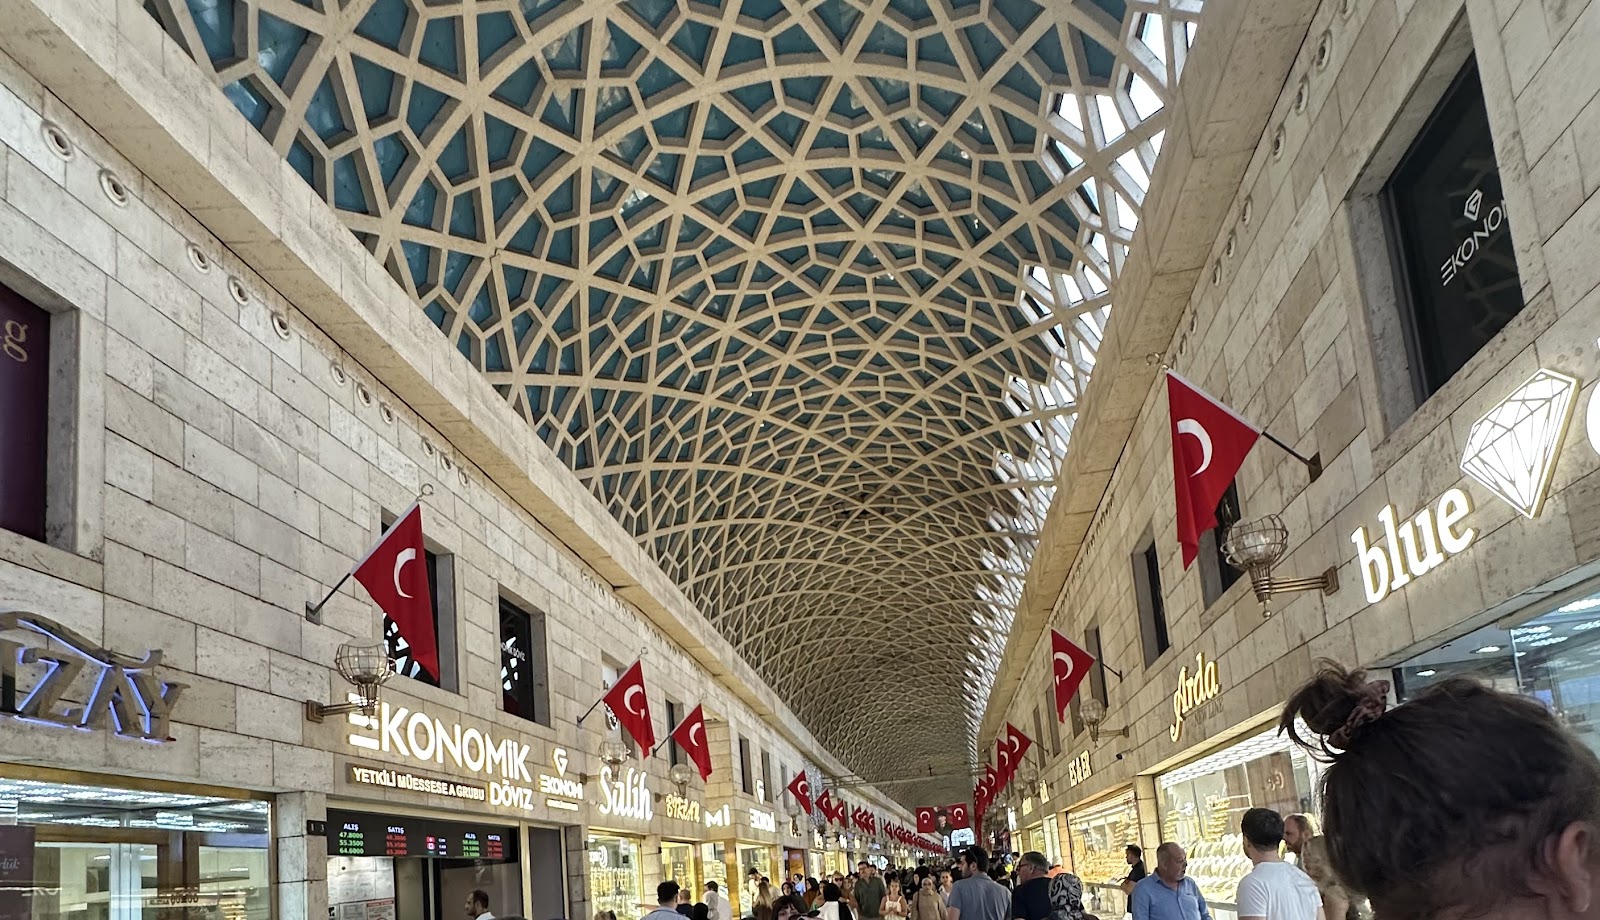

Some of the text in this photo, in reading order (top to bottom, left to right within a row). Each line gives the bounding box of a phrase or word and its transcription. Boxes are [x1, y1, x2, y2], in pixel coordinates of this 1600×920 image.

[1441, 200, 1507, 286] EKONO
[1351, 487, 1478, 604] blue
[347, 692, 531, 783] EKONOMİK
[1170, 651, 1220, 742] Arda
[353, 767, 485, 800] YETKİLİ MÜESSESE A GRUBU
[599, 766, 653, 821] Salih
[343, 823, 405, 835] ALIŞ SATIŞ
